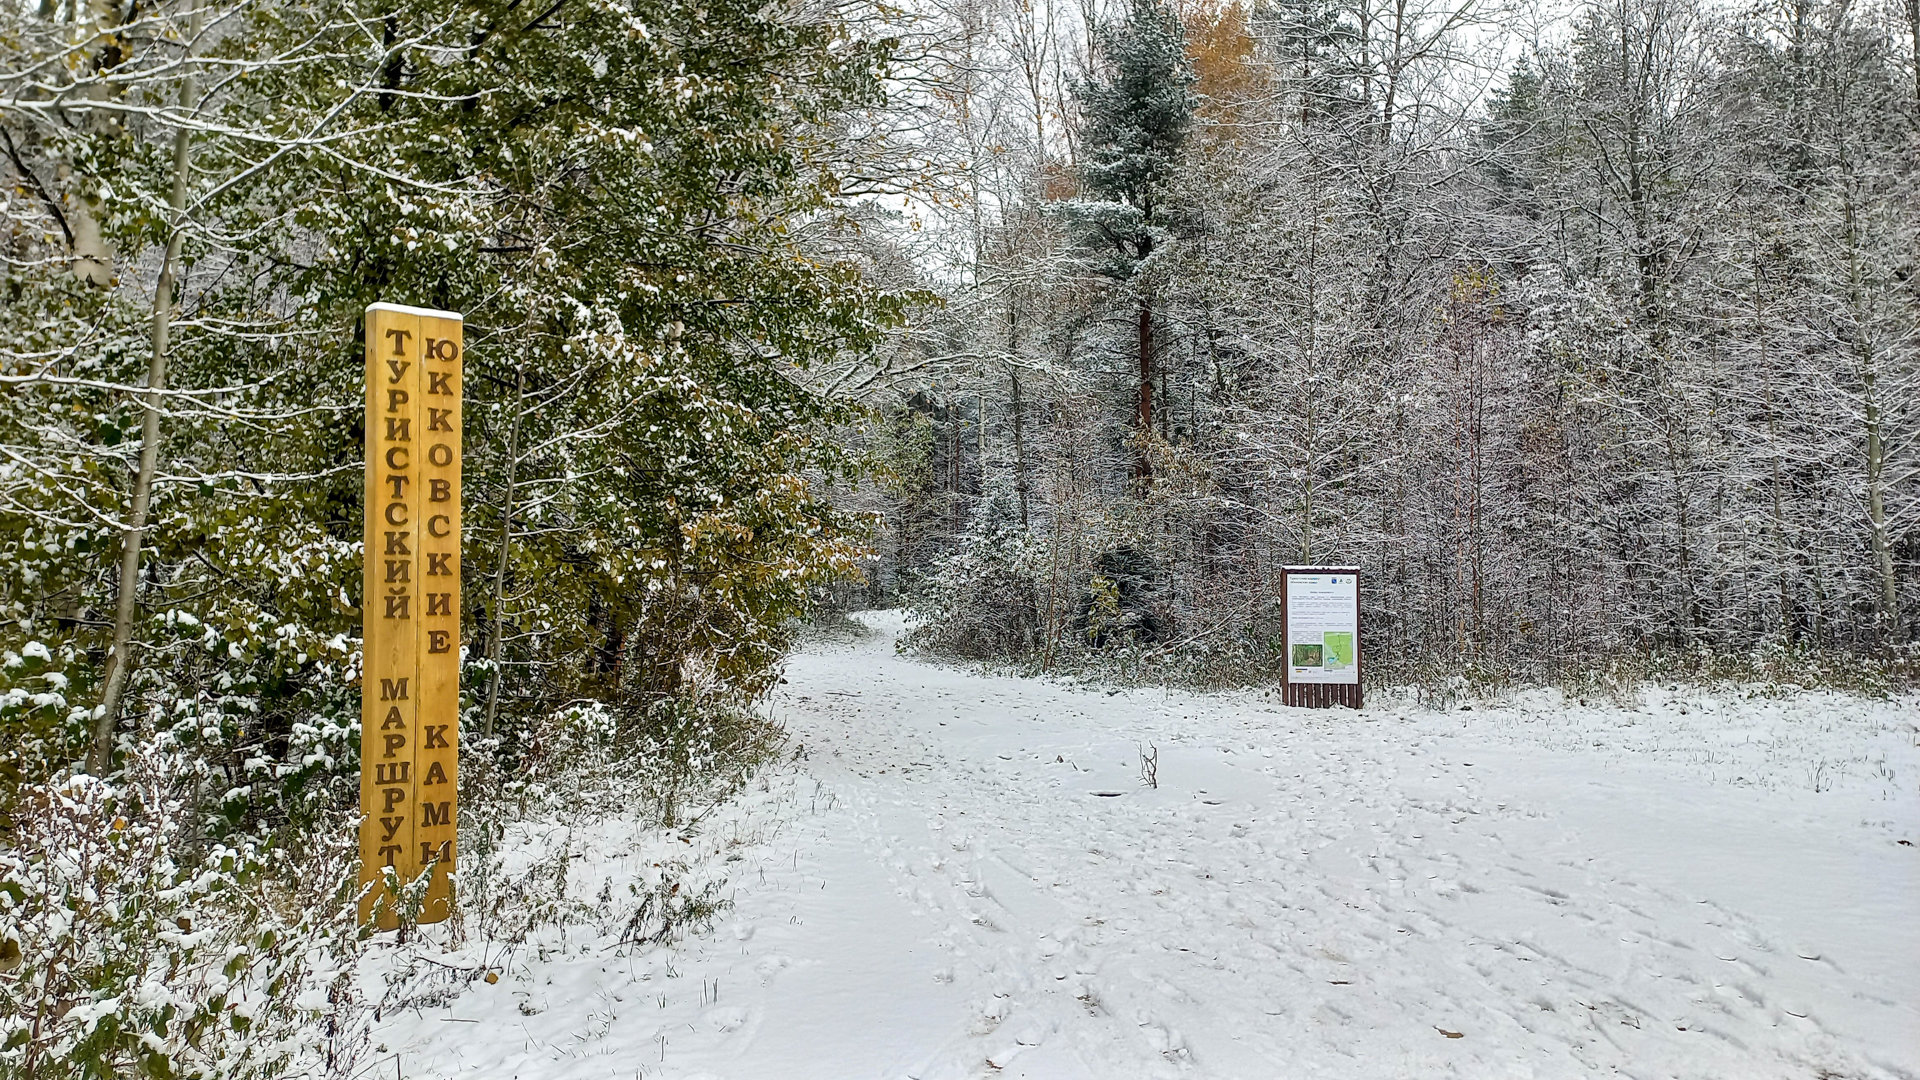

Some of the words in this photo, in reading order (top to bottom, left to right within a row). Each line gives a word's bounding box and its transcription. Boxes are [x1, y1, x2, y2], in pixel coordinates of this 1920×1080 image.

[383, 328, 411, 620] ТУРИСТСКИЙ
[425, 337, 459, 654] ЮККОВСКИЕ
[375, 677, 410, 867] МАРШРУТ
[419, 724, 451, 866] КАМЫ
